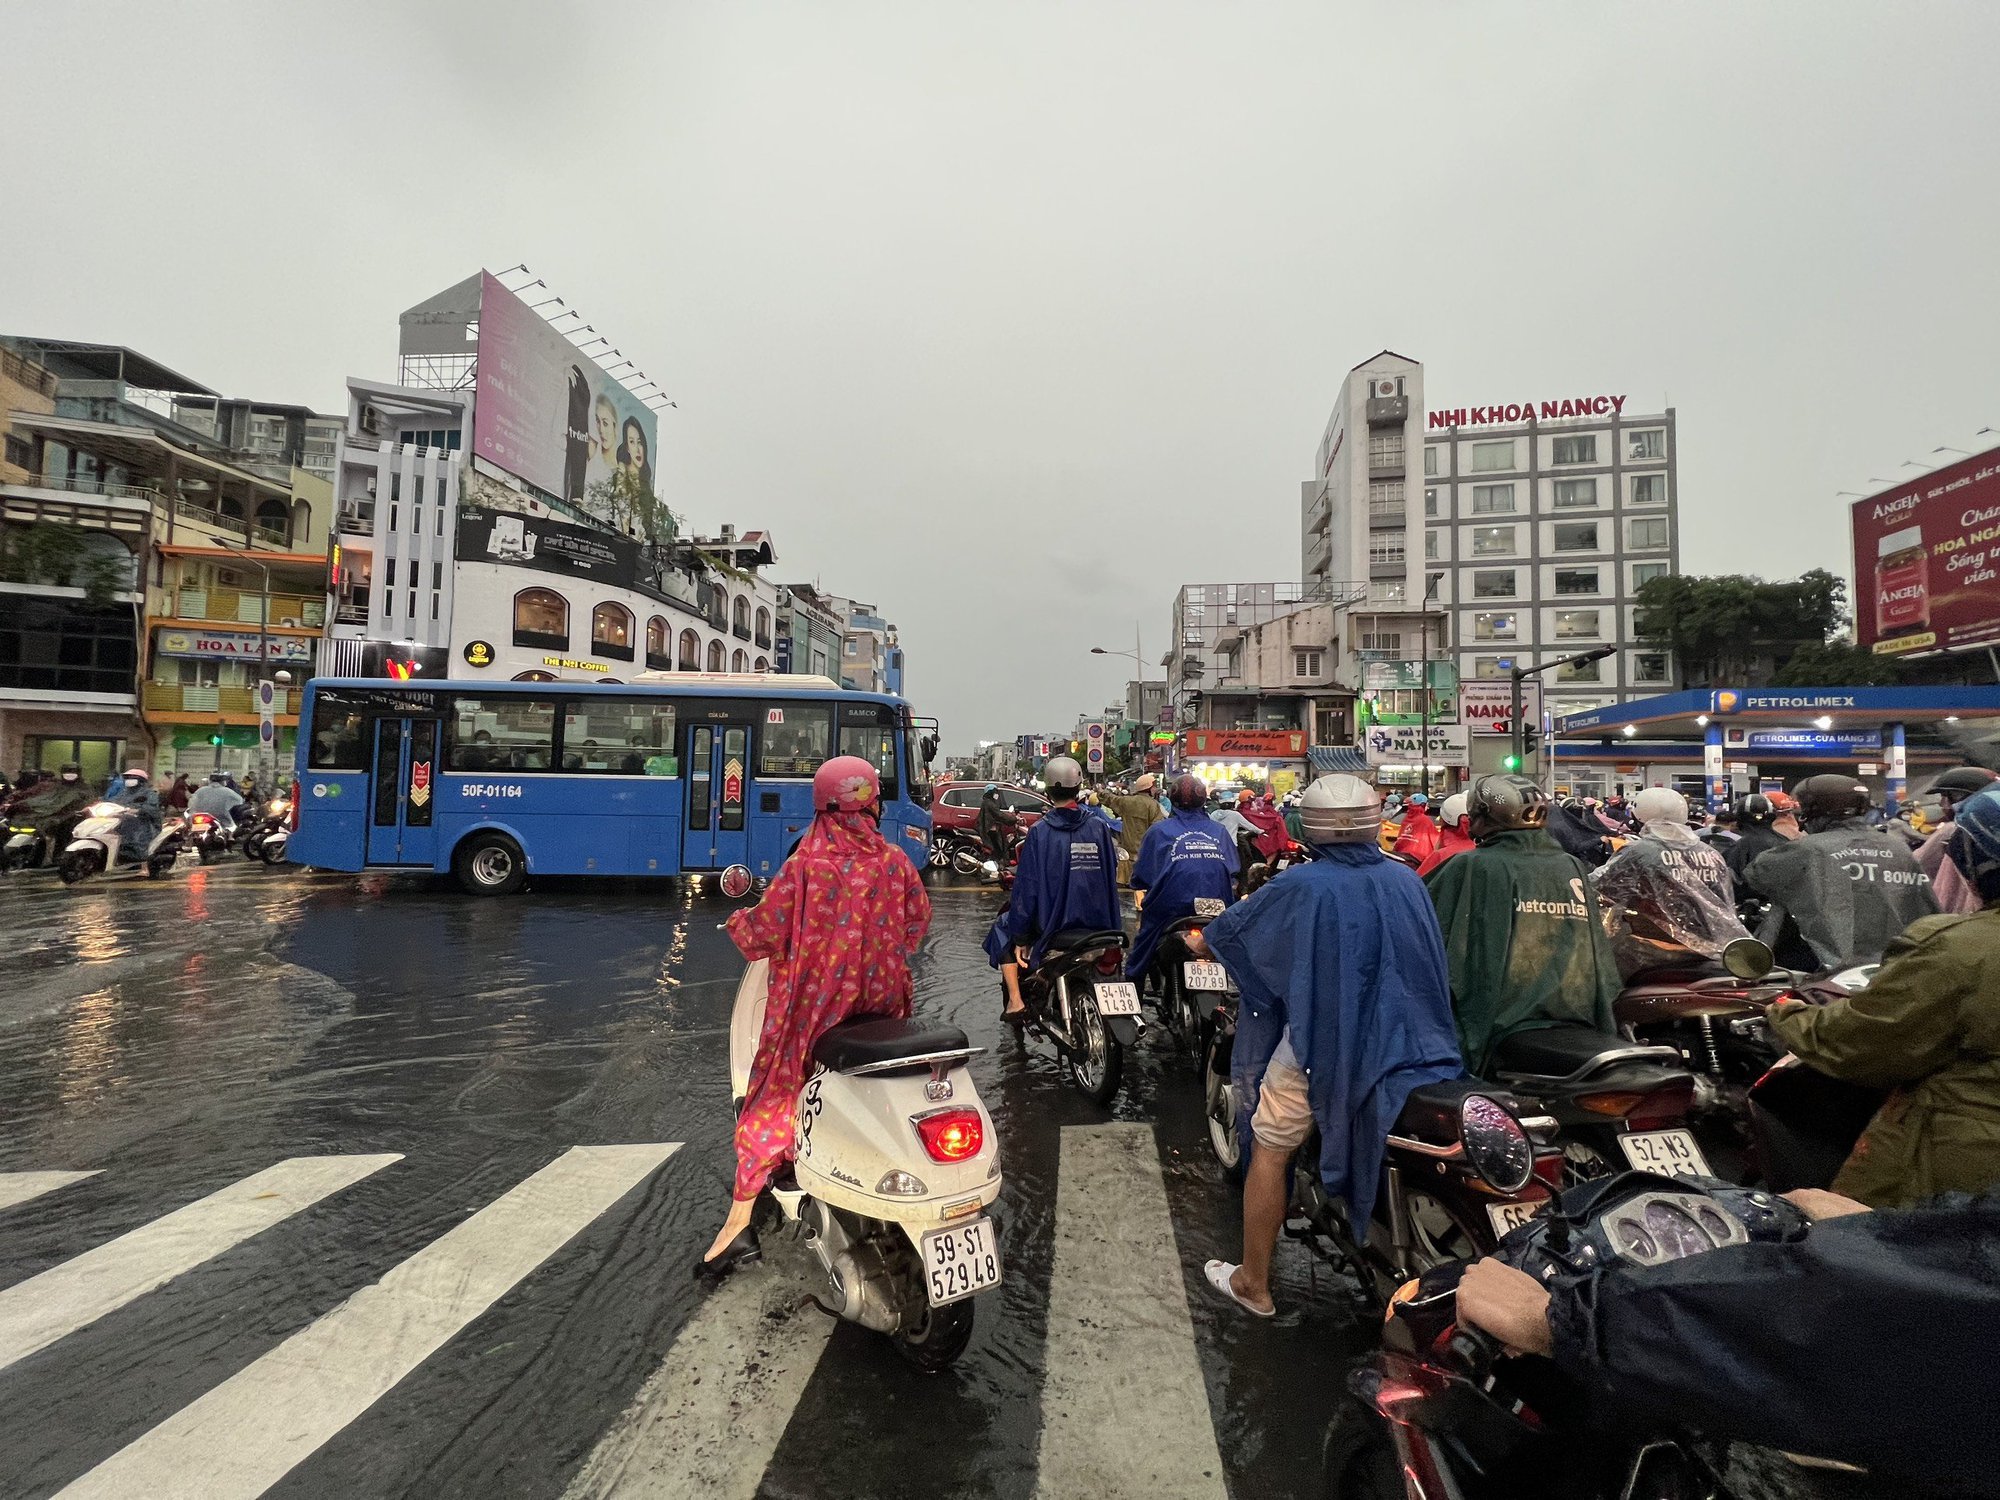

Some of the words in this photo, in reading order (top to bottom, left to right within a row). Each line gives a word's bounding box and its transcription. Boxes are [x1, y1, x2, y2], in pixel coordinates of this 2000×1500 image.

[1429, 408, 1467, 429] NHI
[1471, 403, 1537, 425] KHOA
[1541, 394, 1627, 419] NANCY
[1872, 493, 1921, 520] ANGELA
[1934, 536, 1967, 555] HOA
[1946, 551, 1985, 572] Sống
[1879, 583, 1925, 605] ANGELA
[196, 640, 237, 652] HOA
[1747, 697, 1855, 707] PETROLIMEX
[769, 711, 782, 722] 01
[848, 709, 877, 717] SAMCO
[1397, 727, 1414, 737] NHÀ
[1415, 726, 1445, 737] TUỐC
[1394, 739, 1450, 751] NANCY
[1837, 734, 1865, 743] HÀNG
[1220, 739, 1263, 753] Cherry
[462, 784, 522, 798] 50F-01164
[1188, 976, 1225, 988] 207.89
[1101, 985, 1131, 998] 54-H4
[1104, 999, 1135, 1012] 1438
[1631, 1135, 1690, 1161] 52-N3
[933, 1225, 984, 1265] 59-S1
[931, 1254, 996, 1300] 529.48
